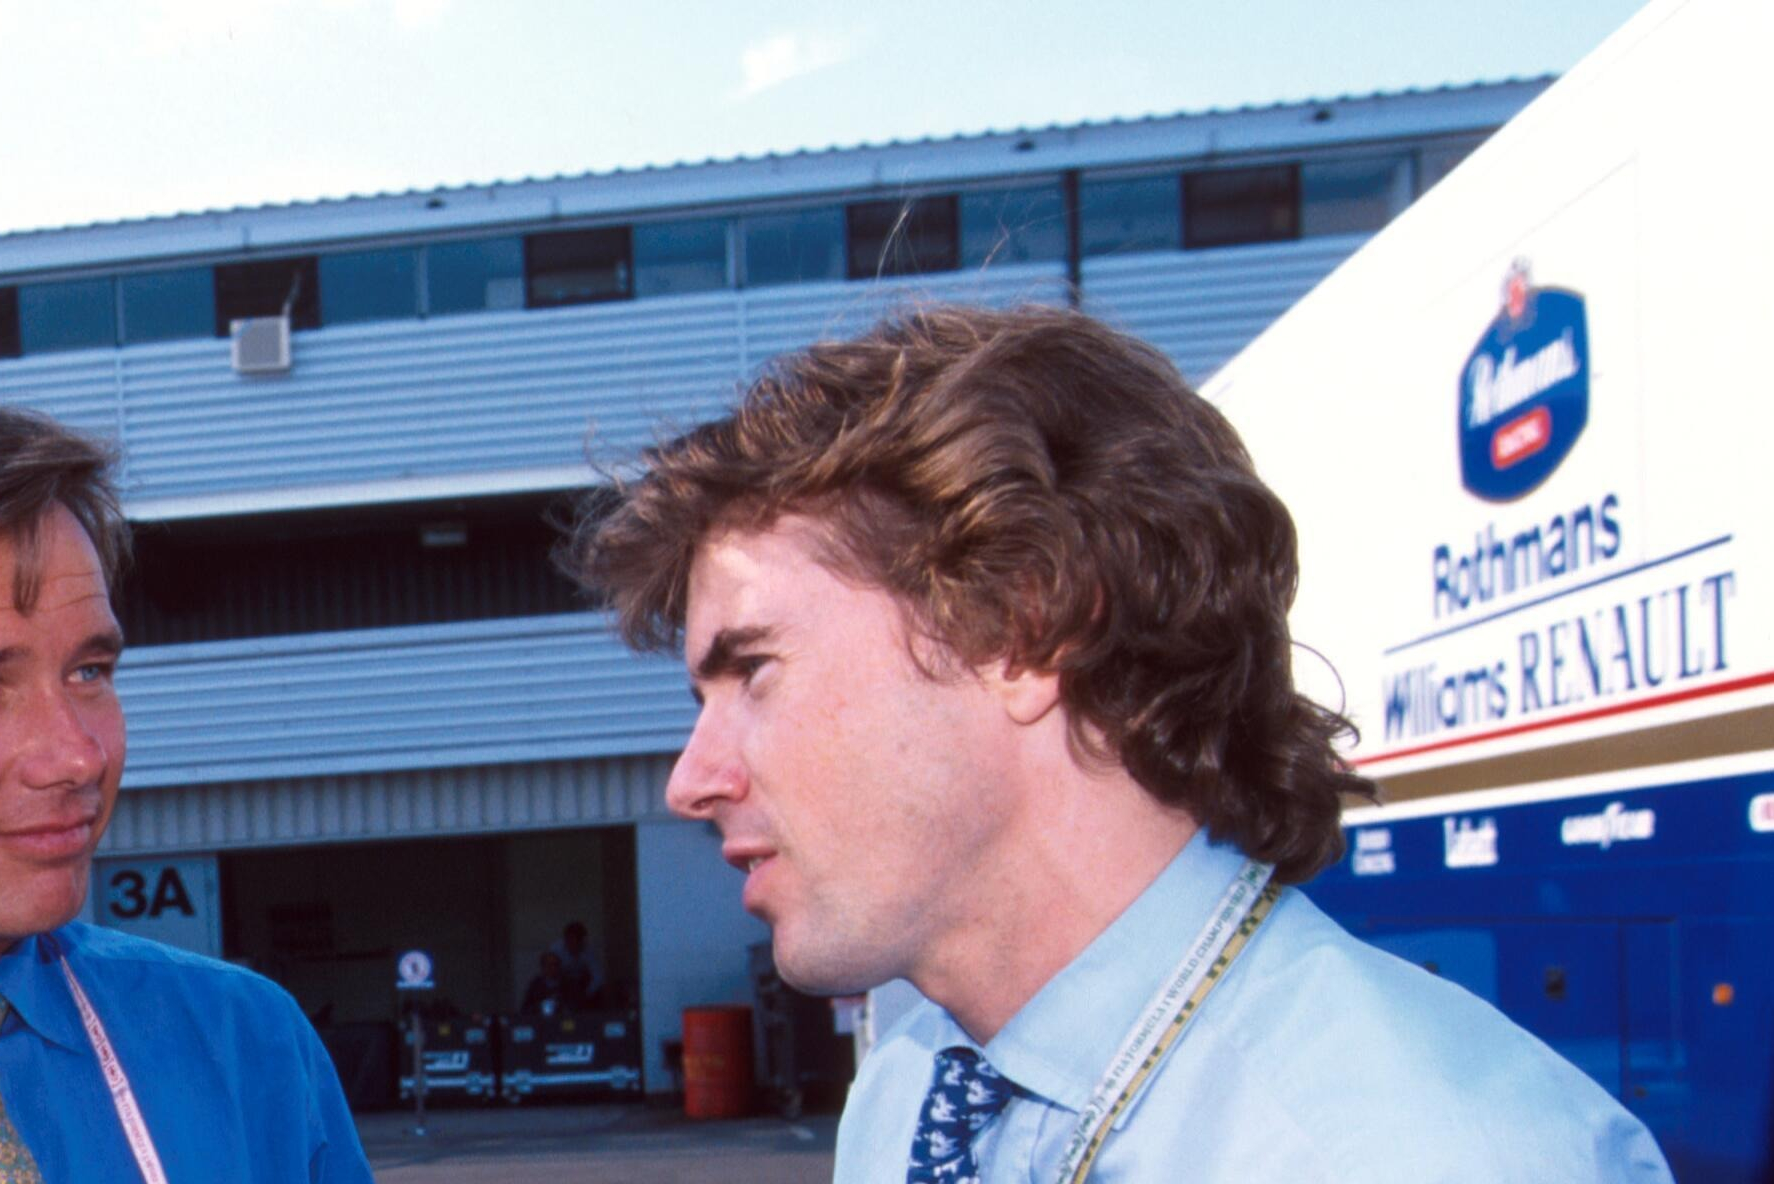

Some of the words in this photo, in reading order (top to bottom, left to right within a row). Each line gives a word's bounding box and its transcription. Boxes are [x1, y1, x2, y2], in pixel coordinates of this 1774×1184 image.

[1432, 494, 1620, 619] Rothmans
[1383, 661, 1508, 742] Williams
[1517, 570, 1737, 714] RENAULT
[110, 867, 194, 919] 3A
[1164, 956, 1199, 1001] WORLD
